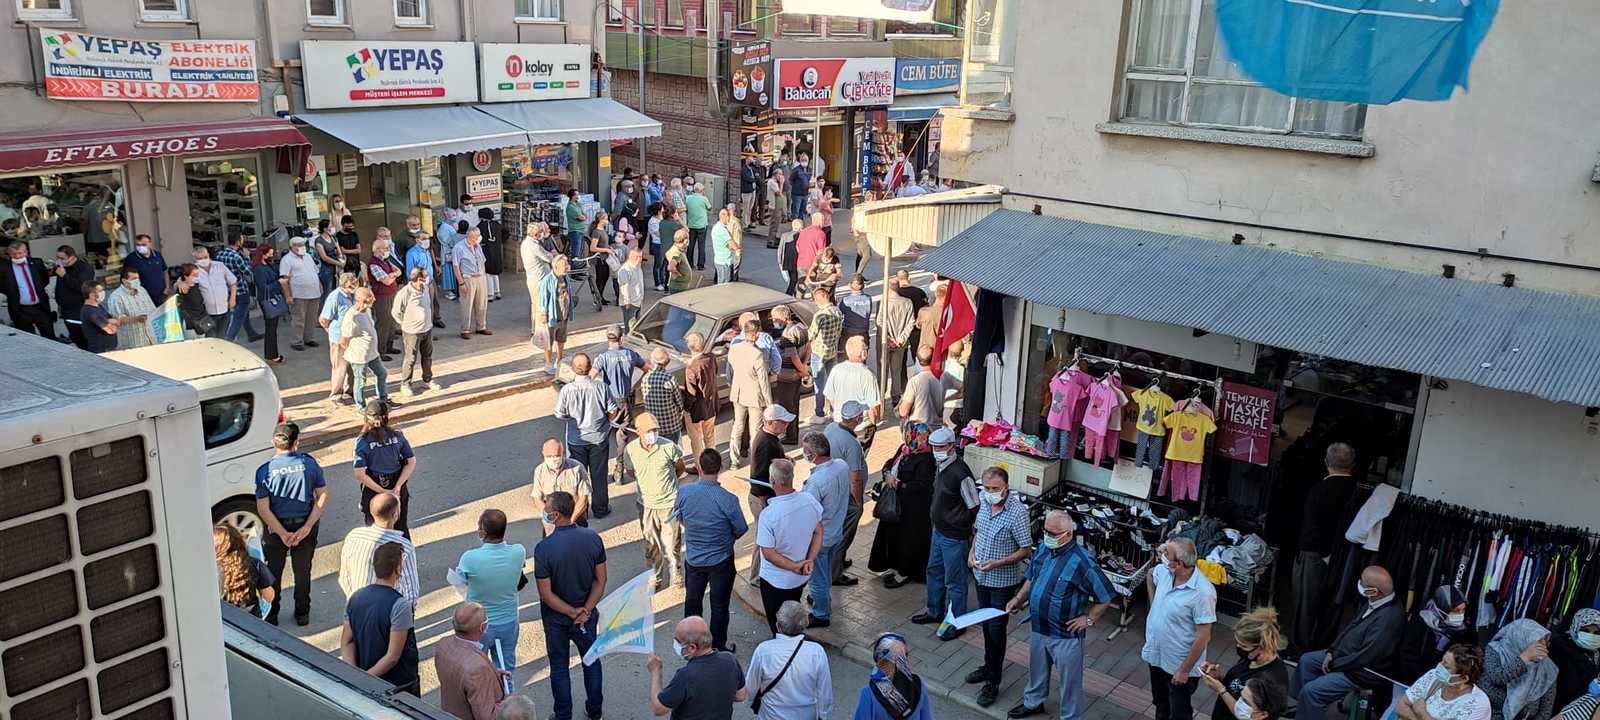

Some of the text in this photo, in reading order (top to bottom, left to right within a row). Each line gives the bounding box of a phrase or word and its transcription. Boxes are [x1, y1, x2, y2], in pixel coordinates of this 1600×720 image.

[77, 35, 162, 60] YEPAŞ
[170, 42, 250, 54] ELEKTRİK
[168, 55, 253, 67] ABONELİĞİ
[372, 48, 444, 75] YEPAŞ
[525, 60, 554, 76] kolay
[52, 65, 152, 79] İNDİRİMLİ ELEKTRİK
[171, 71, 215, 80] ELEKTRİK
[901, 61, 958, 81] CEM BÜFE
[101, 80, 220, 98] BURADA
[784, 85, 831, 100] Babacan
[44, 136, 218, 163] EFTA SHOES
